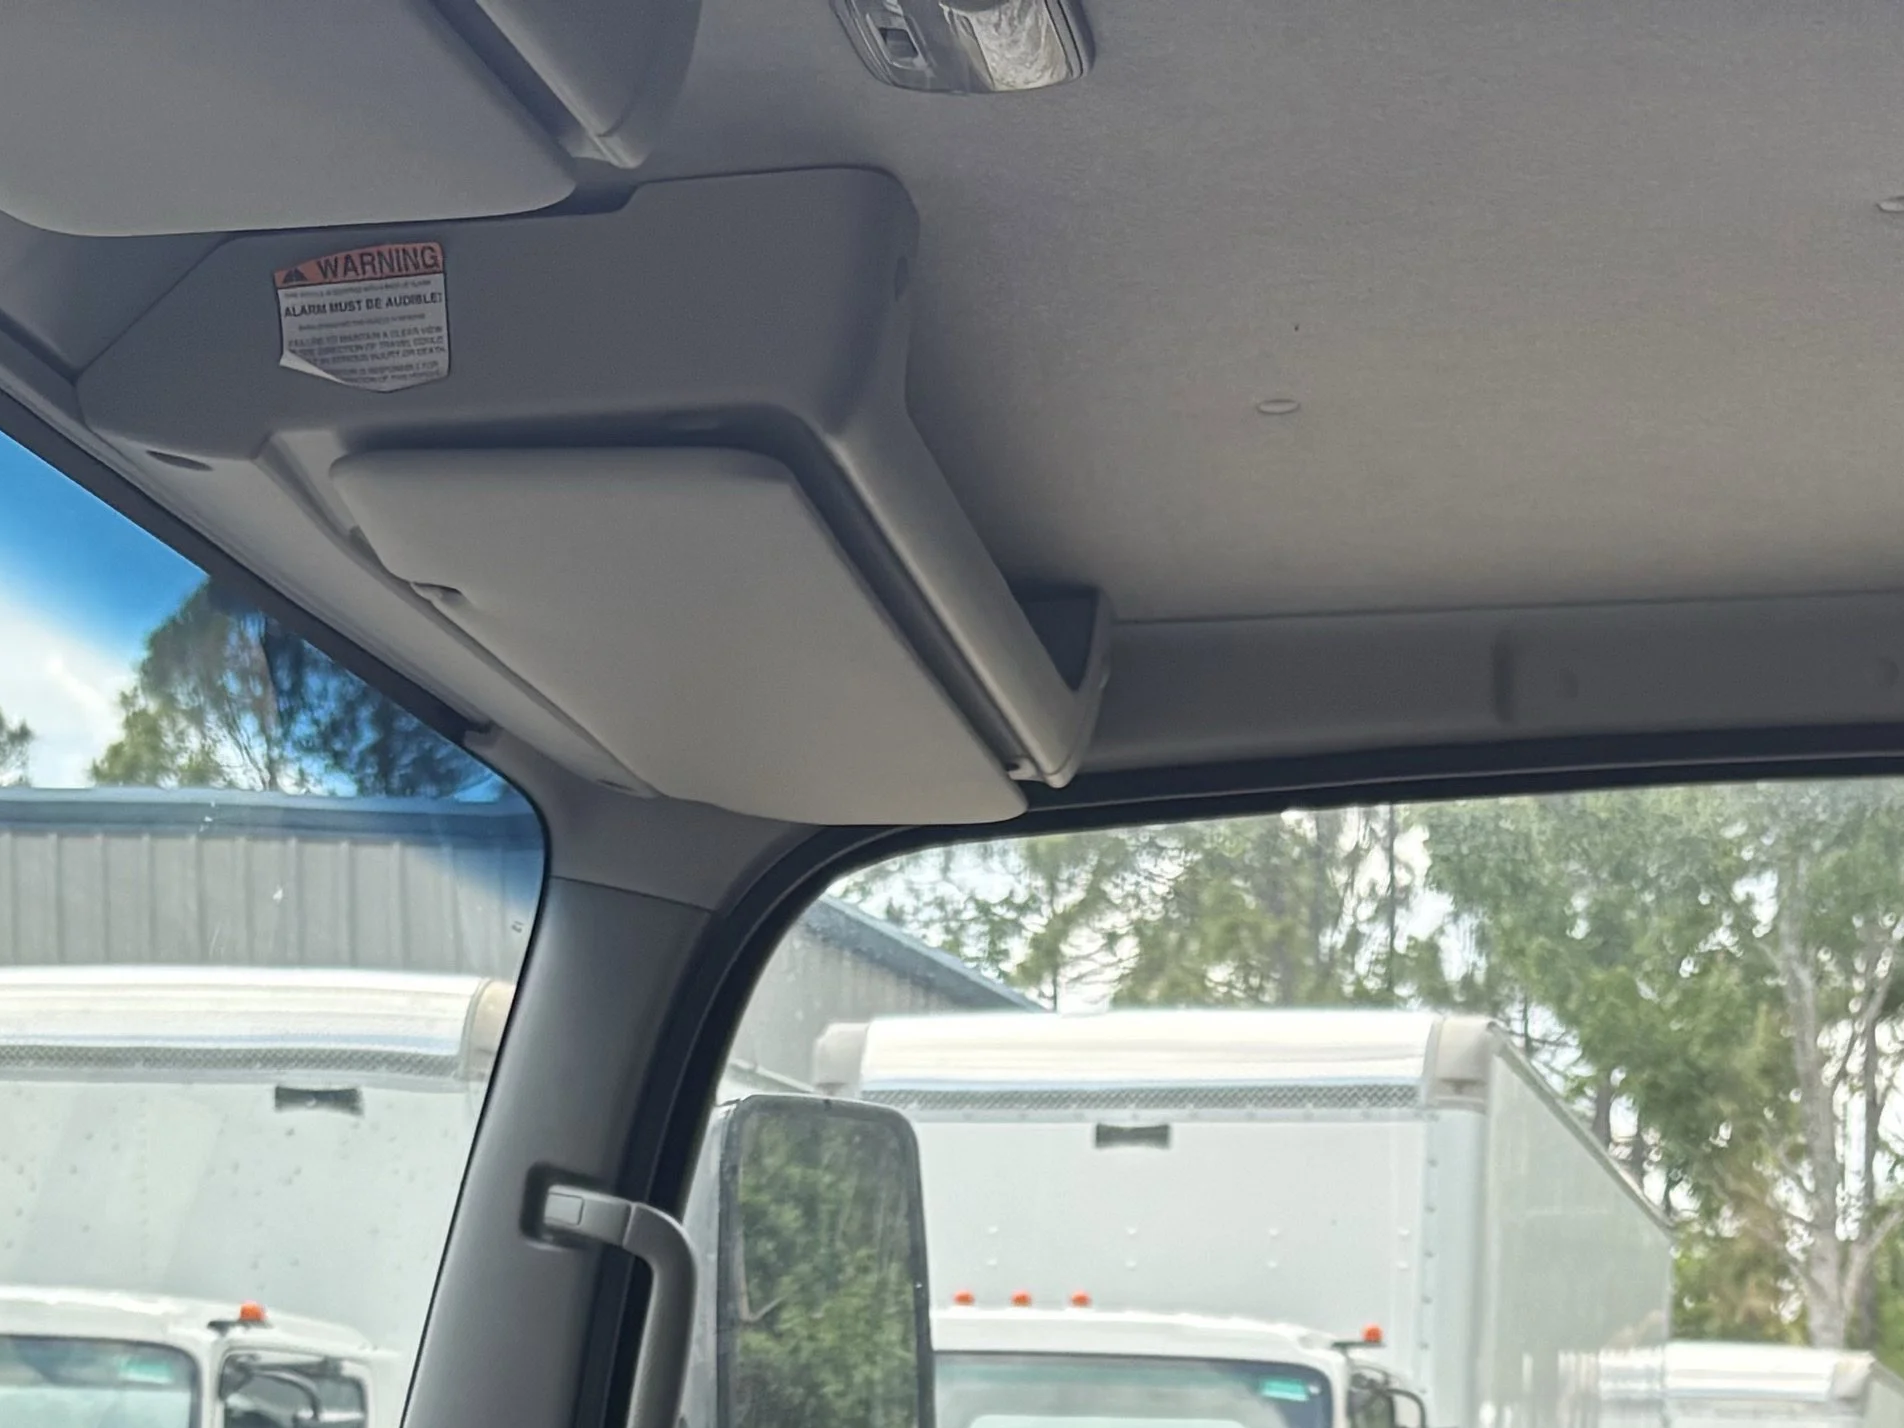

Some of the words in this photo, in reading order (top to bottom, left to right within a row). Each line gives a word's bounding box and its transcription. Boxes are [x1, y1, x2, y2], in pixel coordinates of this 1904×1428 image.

[316, 245, 440, 280] WARNING
[284, 303, 327, 318] ALARM
[329, 300, 362, 313] MUST
[365, 297, 383, 310] BE
